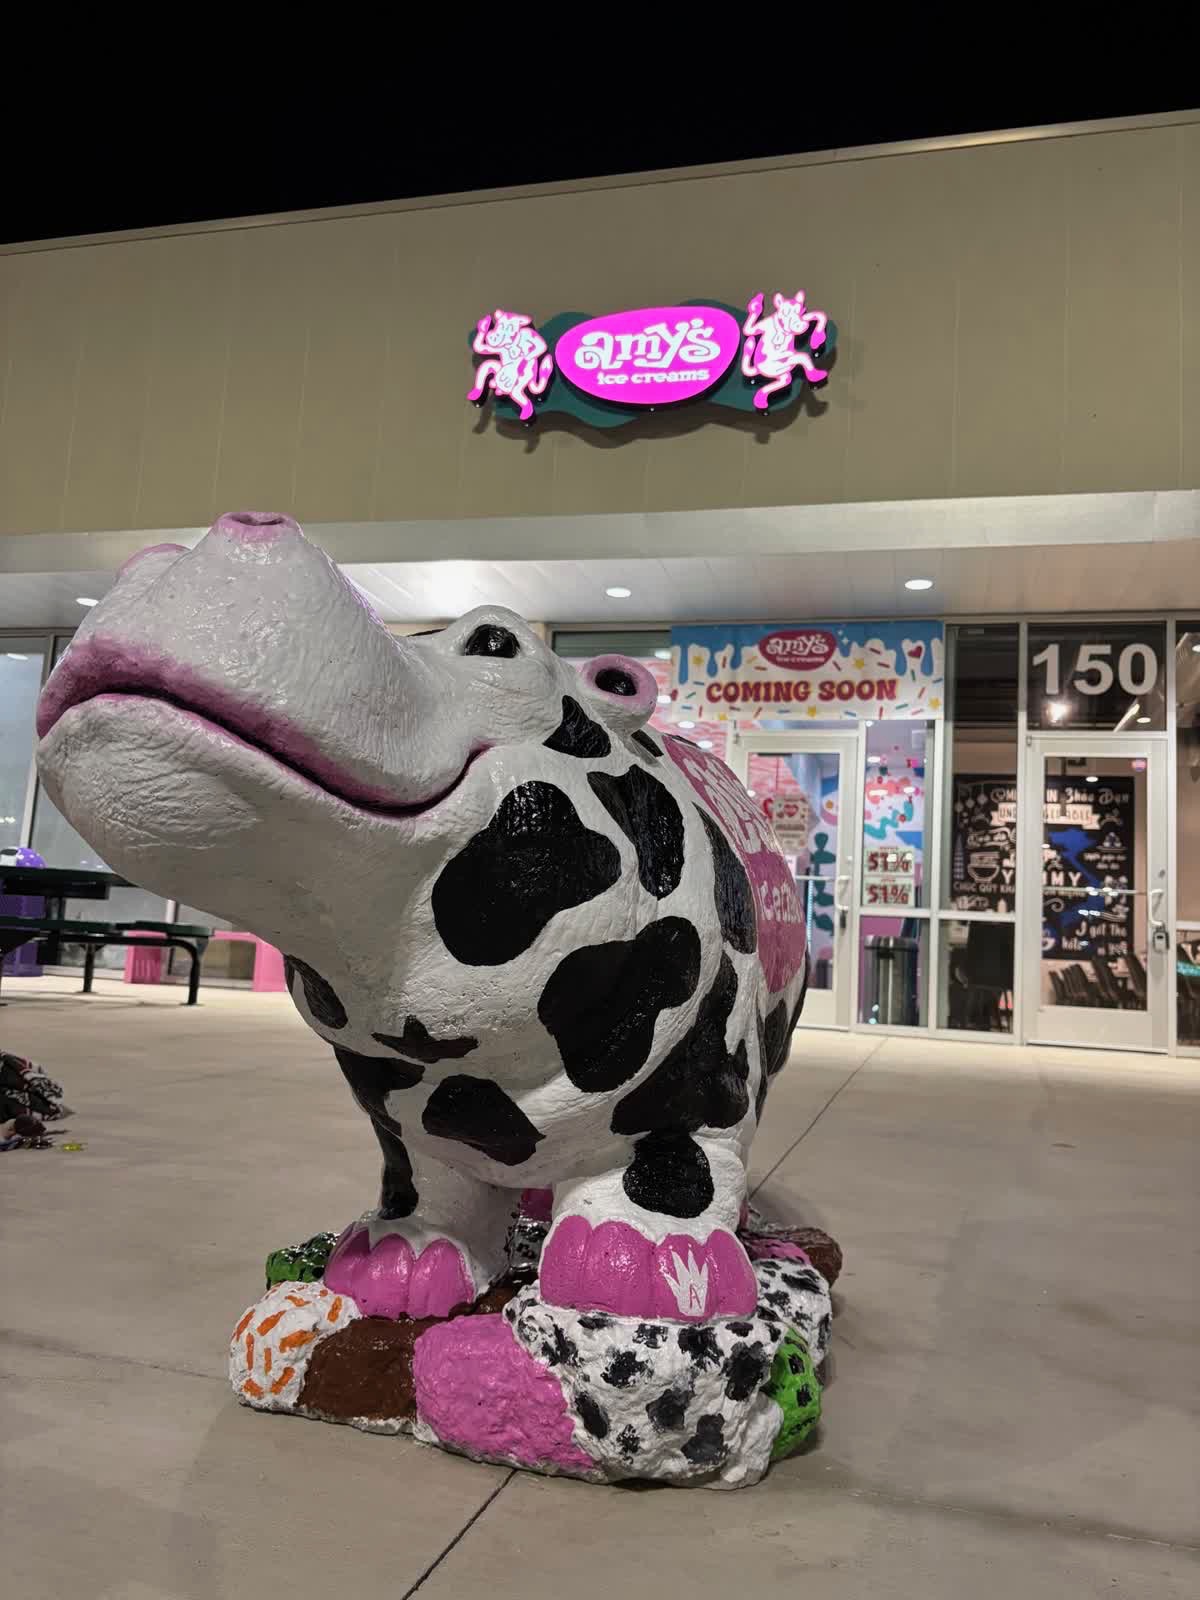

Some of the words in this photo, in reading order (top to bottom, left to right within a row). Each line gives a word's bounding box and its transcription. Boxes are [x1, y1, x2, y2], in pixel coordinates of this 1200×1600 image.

[597, 371, 629, 385] ice
[631, 369, 710, 384] creams
[1032, 643, 1158, 695] 150
[706, 681, 810, 703] COMING
[818, 679, 897, 701] SOON
